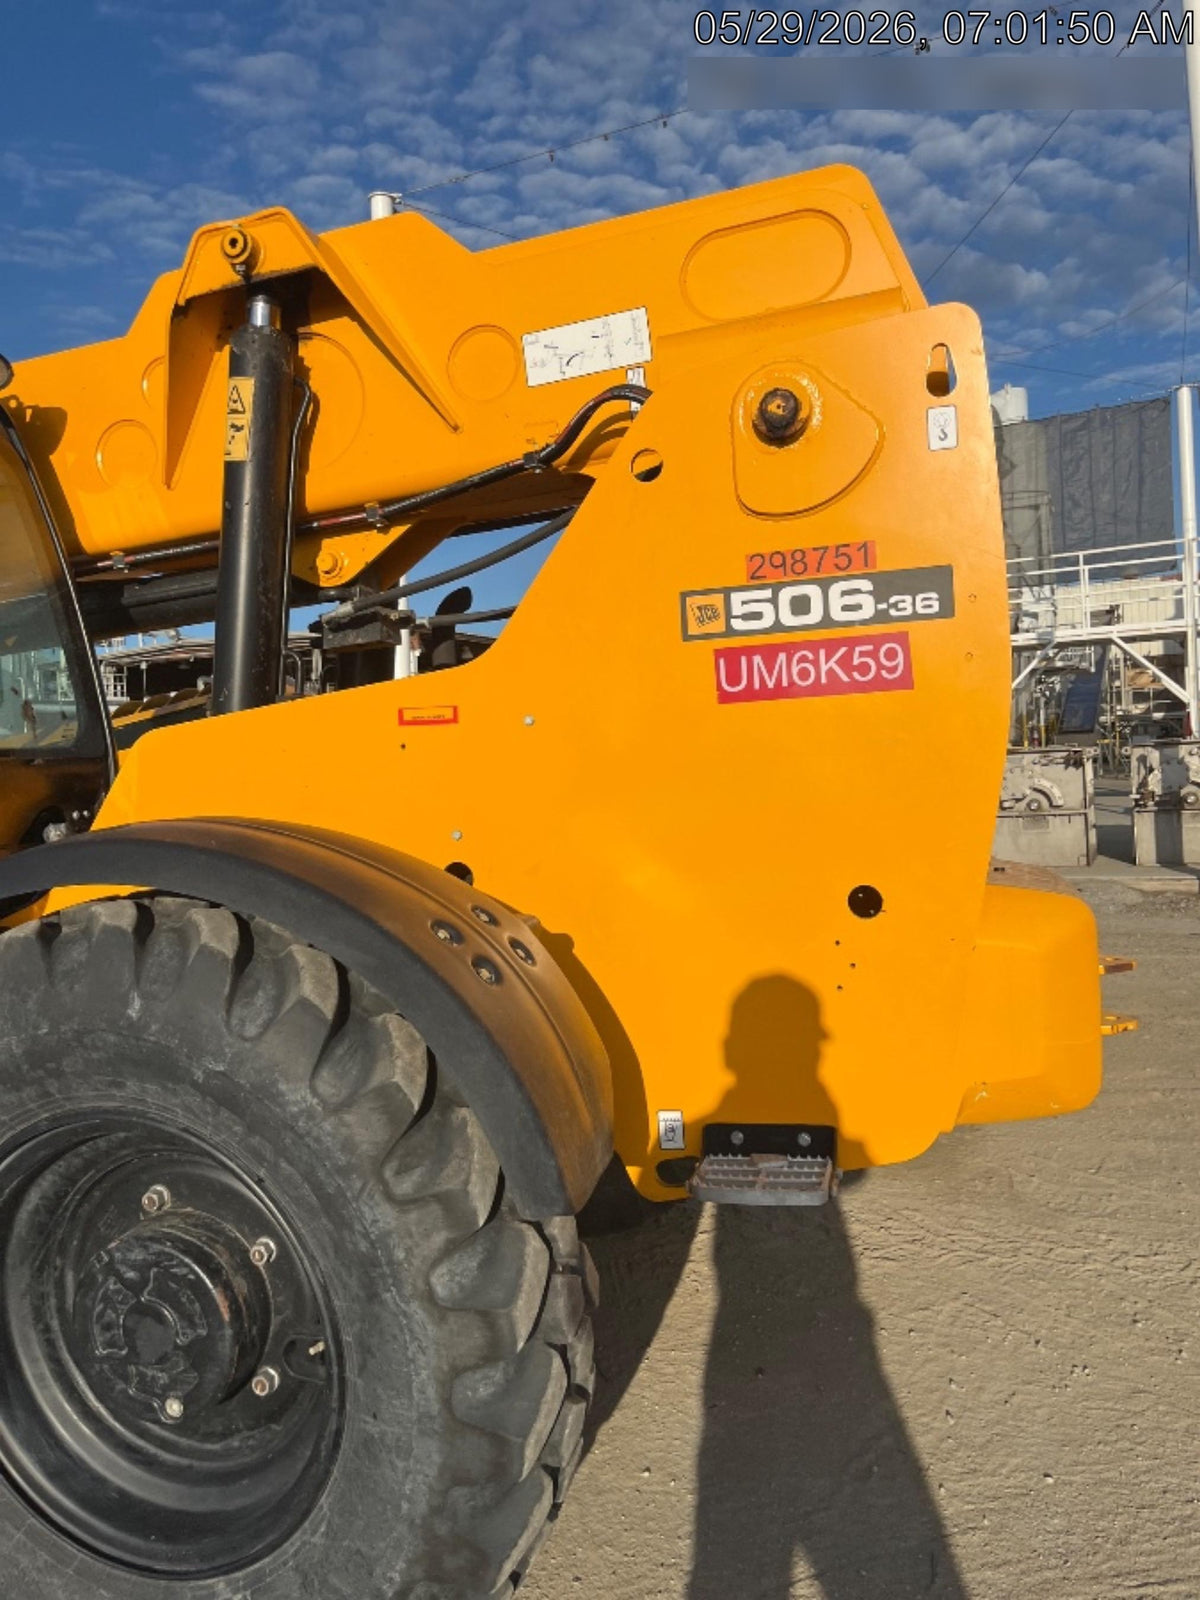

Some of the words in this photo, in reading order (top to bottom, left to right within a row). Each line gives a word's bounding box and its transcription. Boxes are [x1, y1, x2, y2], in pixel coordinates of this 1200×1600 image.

[749, 541, 869, 581] 298751
[730, 579, 940, 630] 506-36
[719, 643, 904, 693] UM6K59
